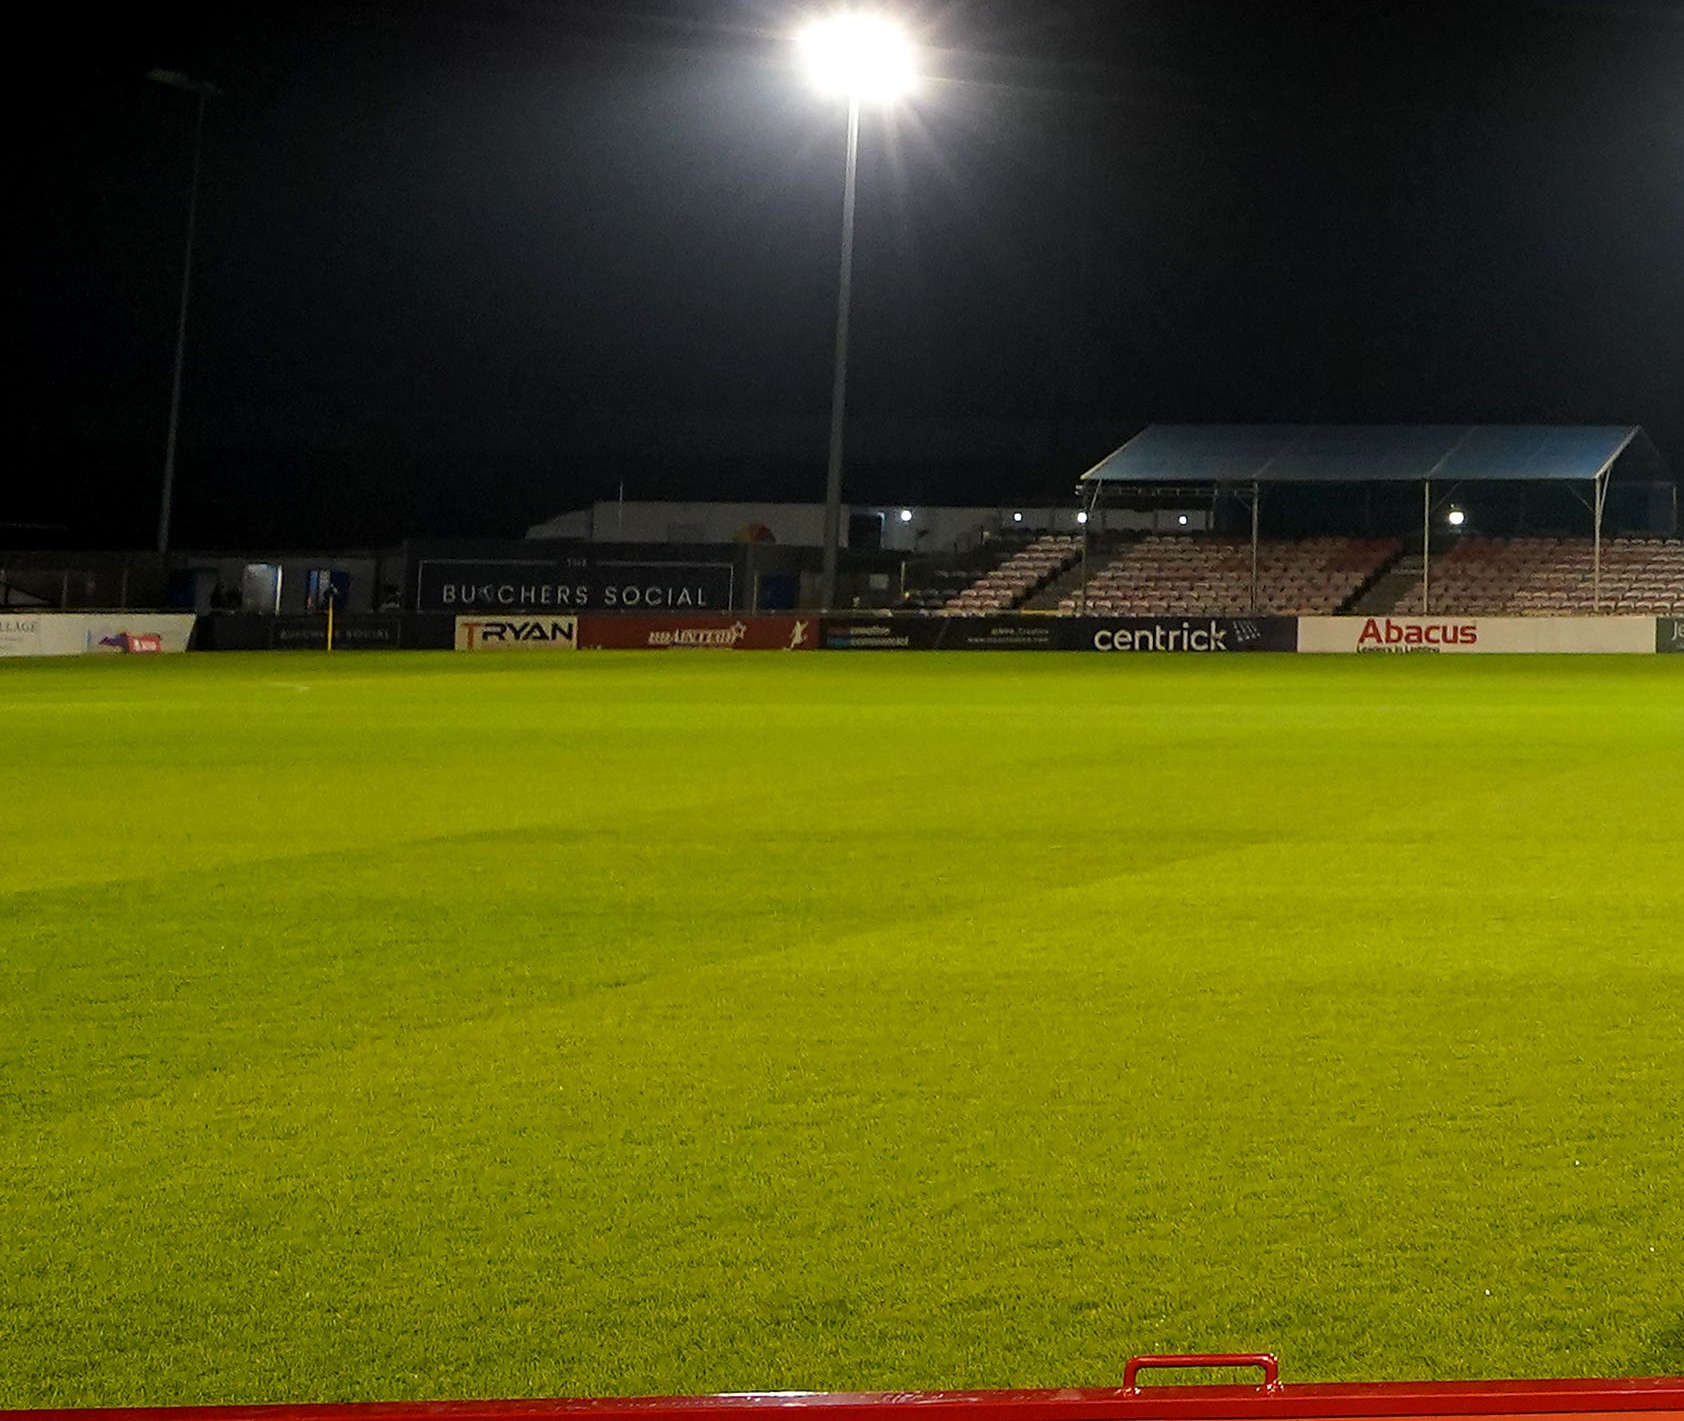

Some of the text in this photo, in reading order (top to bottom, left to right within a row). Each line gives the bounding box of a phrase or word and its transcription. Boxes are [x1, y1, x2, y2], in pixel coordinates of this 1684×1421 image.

[604, 585, 706, 606] SOCIAL
[1094, 620, 1227, 651] centrick
[1359, 618, 1477, 644] Abacus
